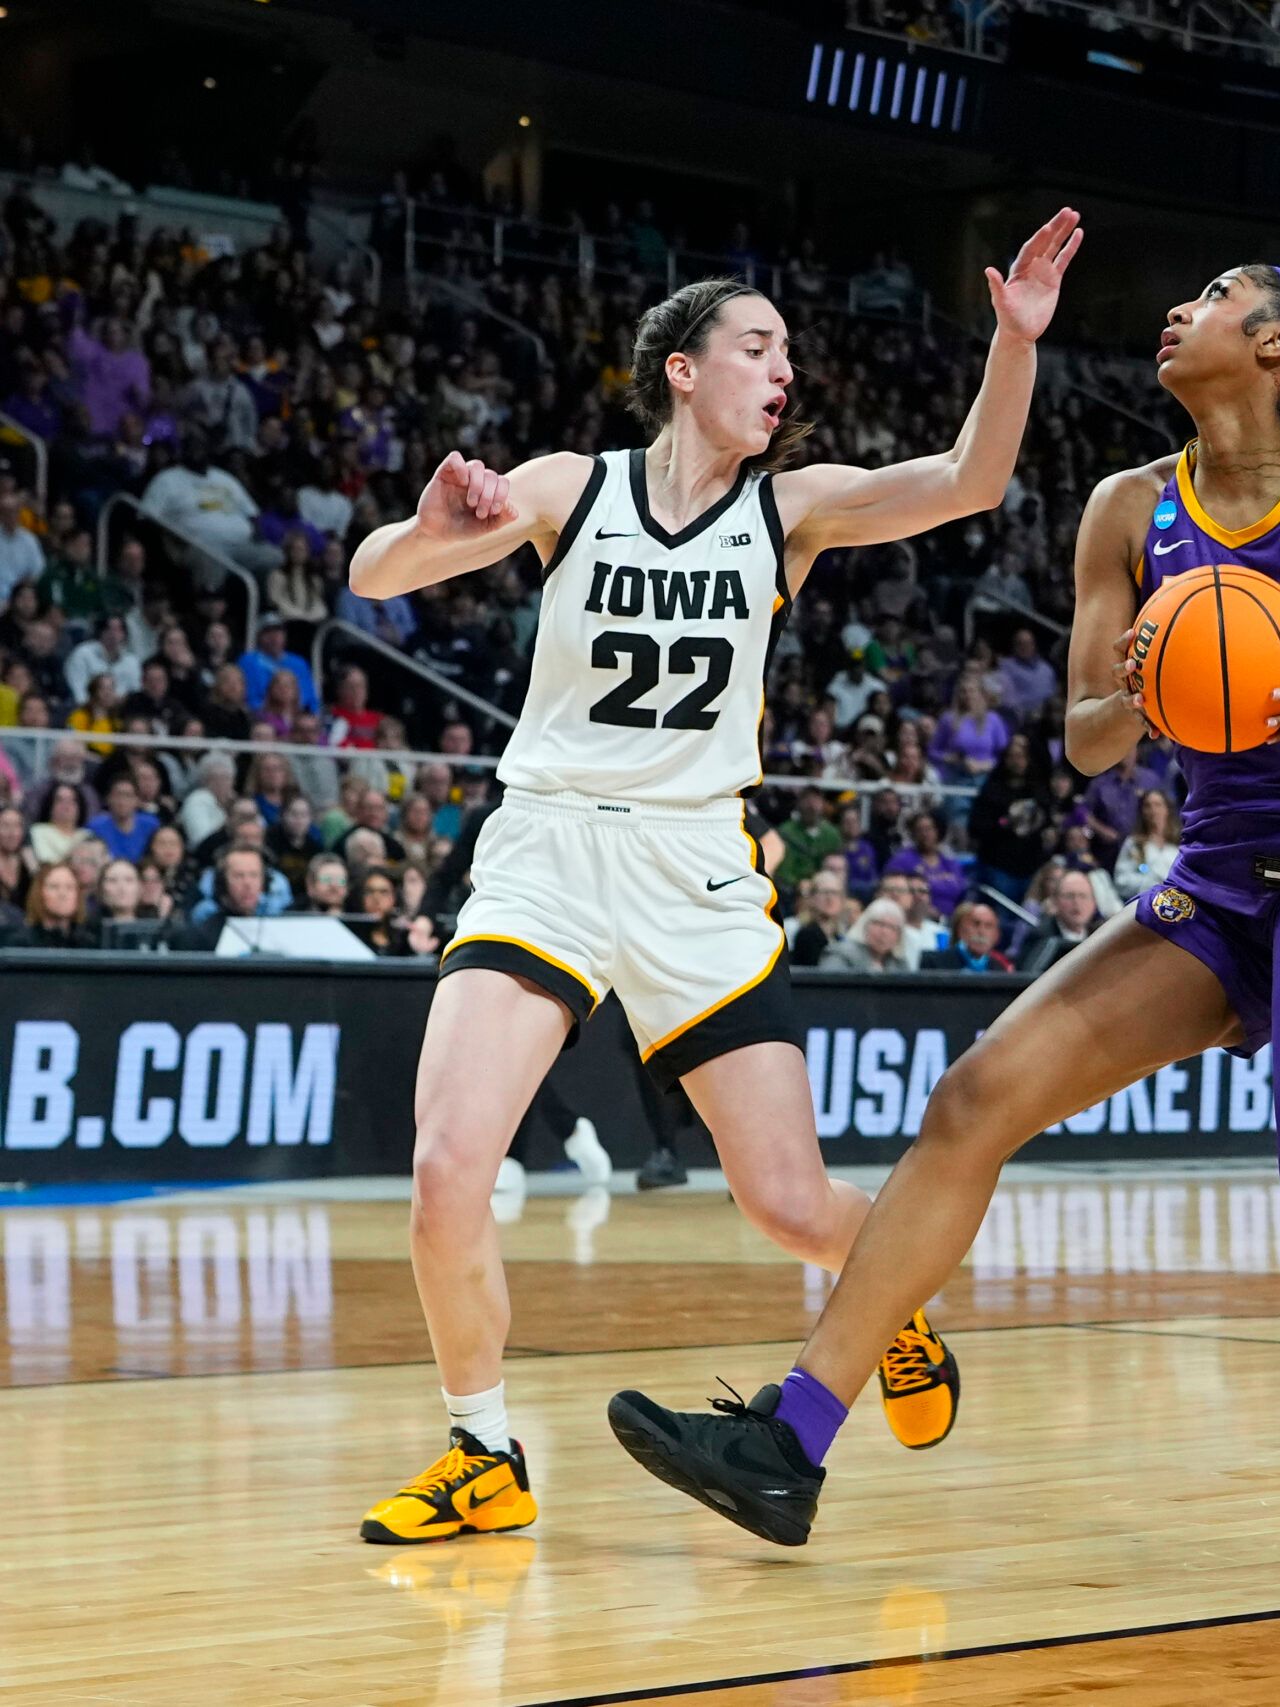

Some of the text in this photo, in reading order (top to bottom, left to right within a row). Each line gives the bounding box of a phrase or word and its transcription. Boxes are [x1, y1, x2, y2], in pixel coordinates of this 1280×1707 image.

[584, 561, 749, 620] IOWA
[589, 631, 734, 730] 22
[806, 1028, 949, 1137] USA
